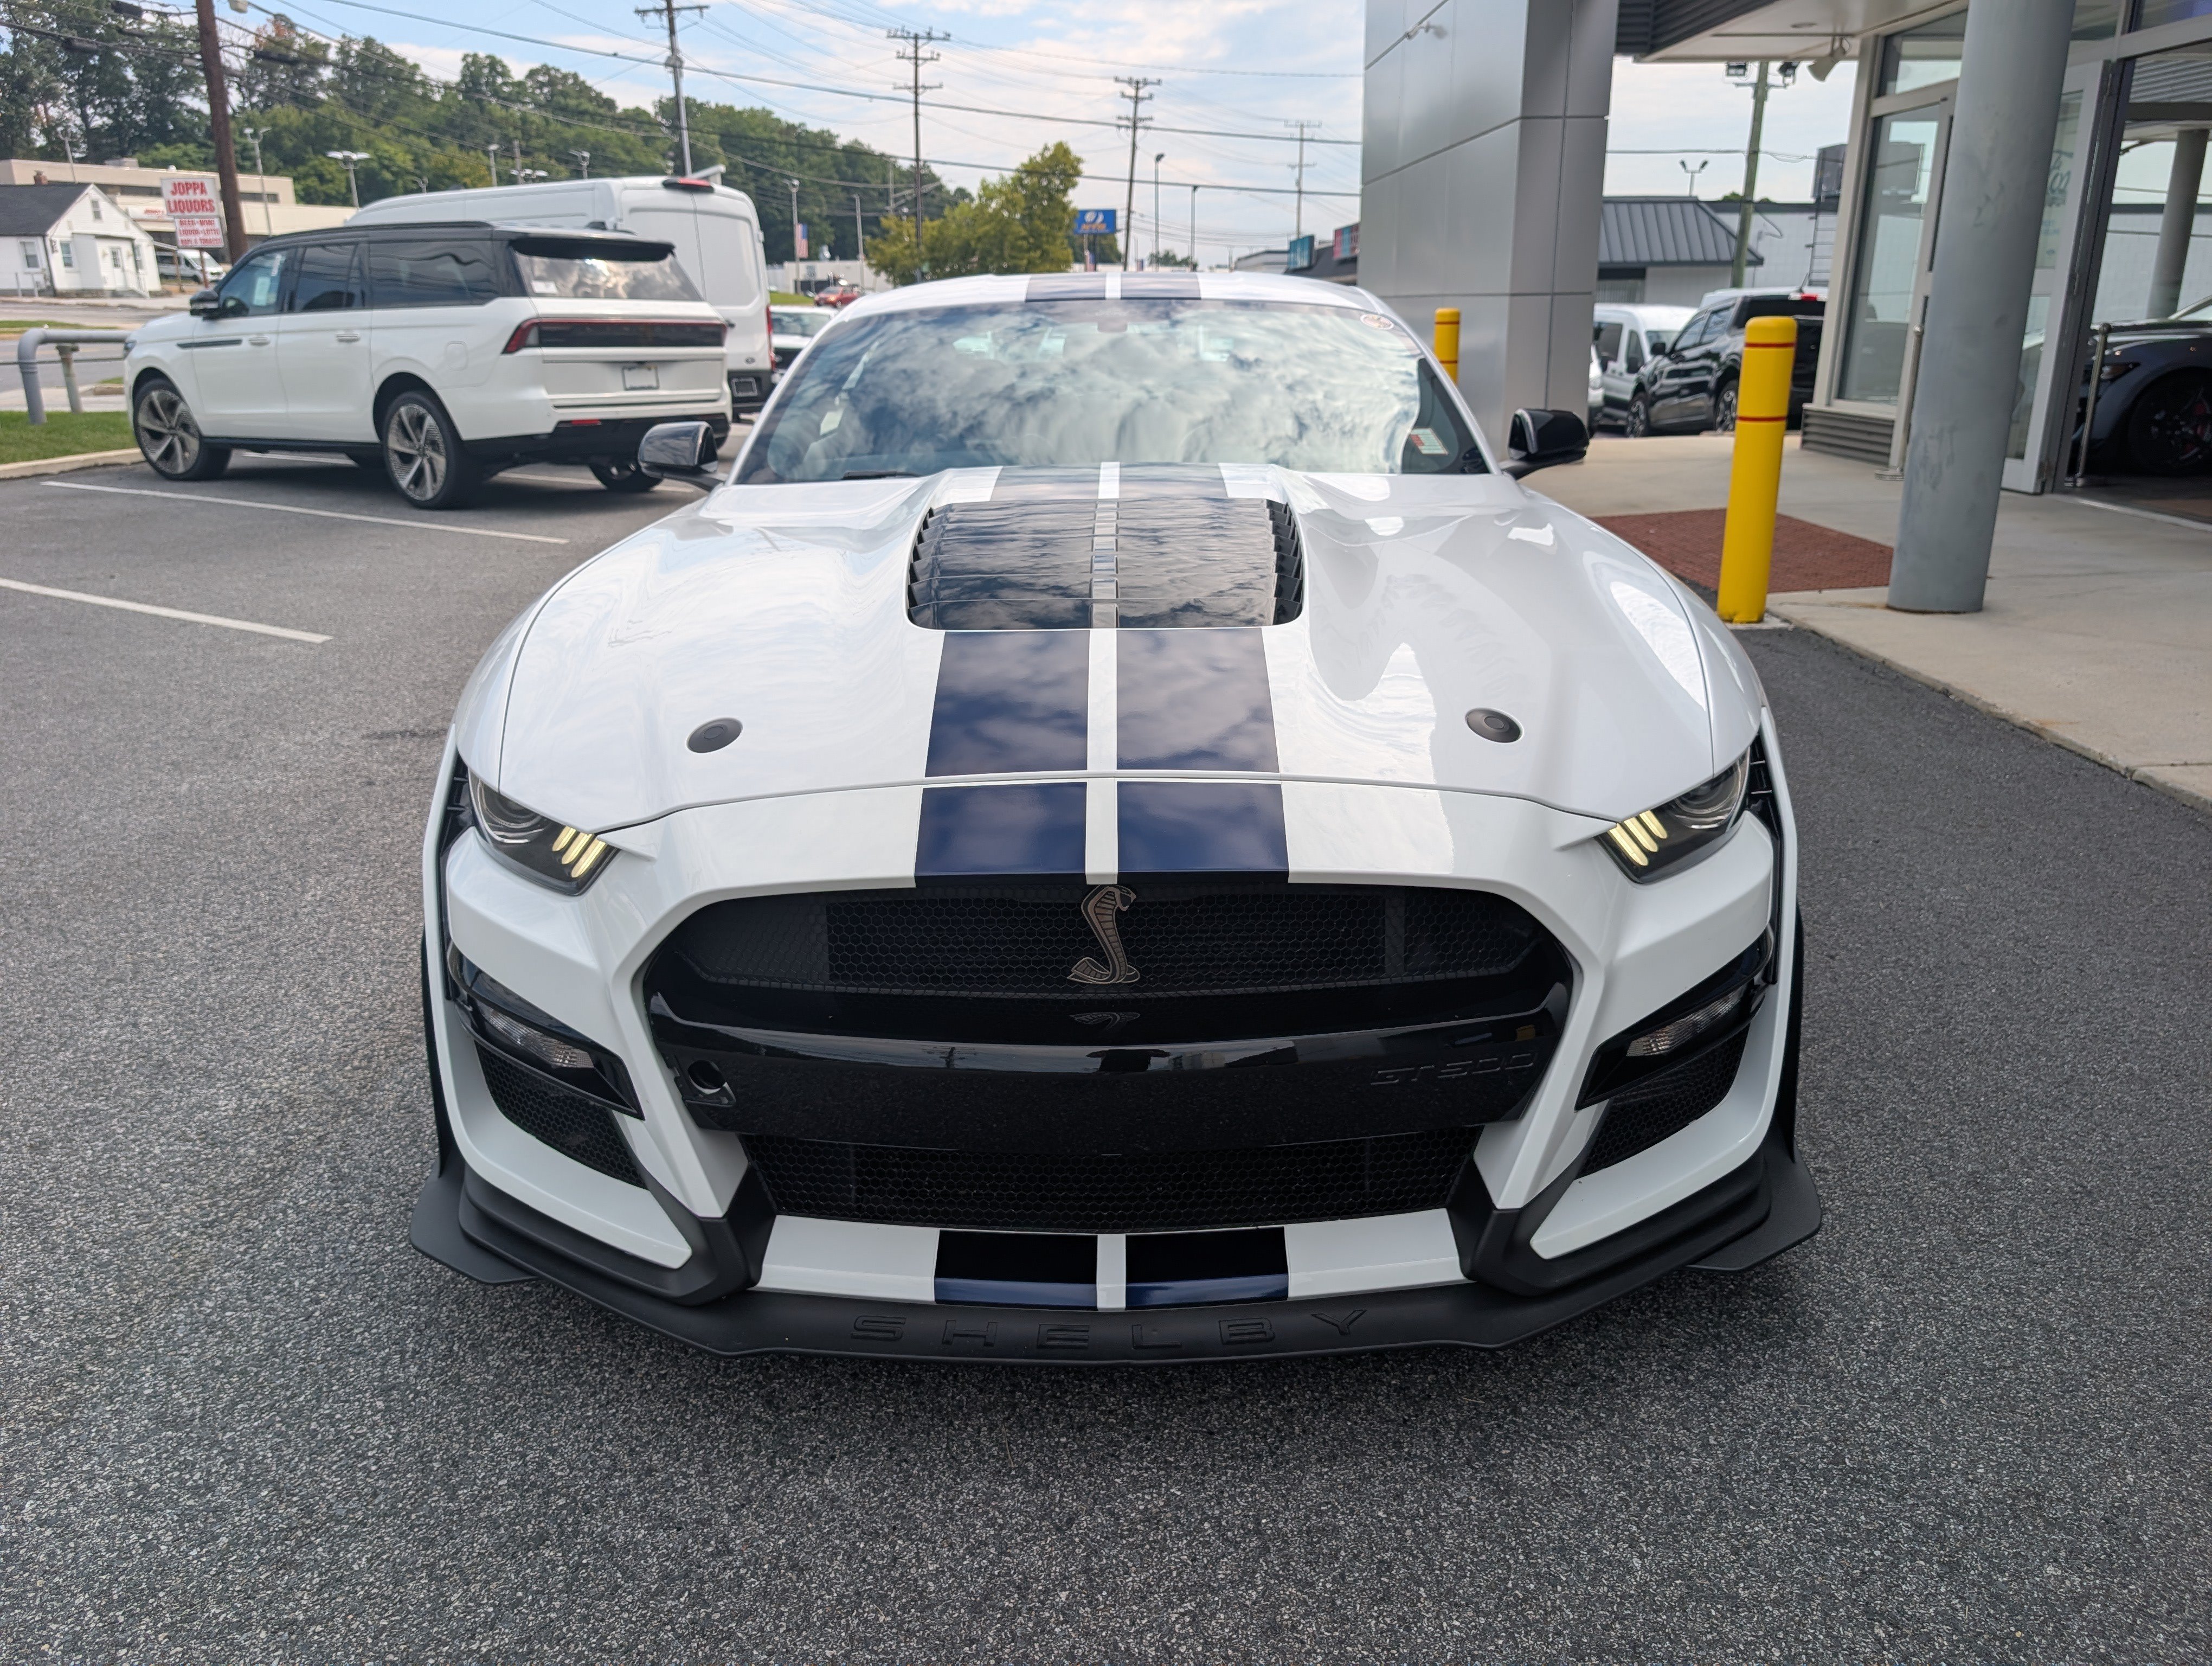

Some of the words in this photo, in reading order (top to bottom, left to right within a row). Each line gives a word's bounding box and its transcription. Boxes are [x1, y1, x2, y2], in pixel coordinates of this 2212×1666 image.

[171, 181, 208, 196] JOPPA
[166, 198, 215, 213] LIQUORS
[851, 1309, 1367, 1350] SHELBY
